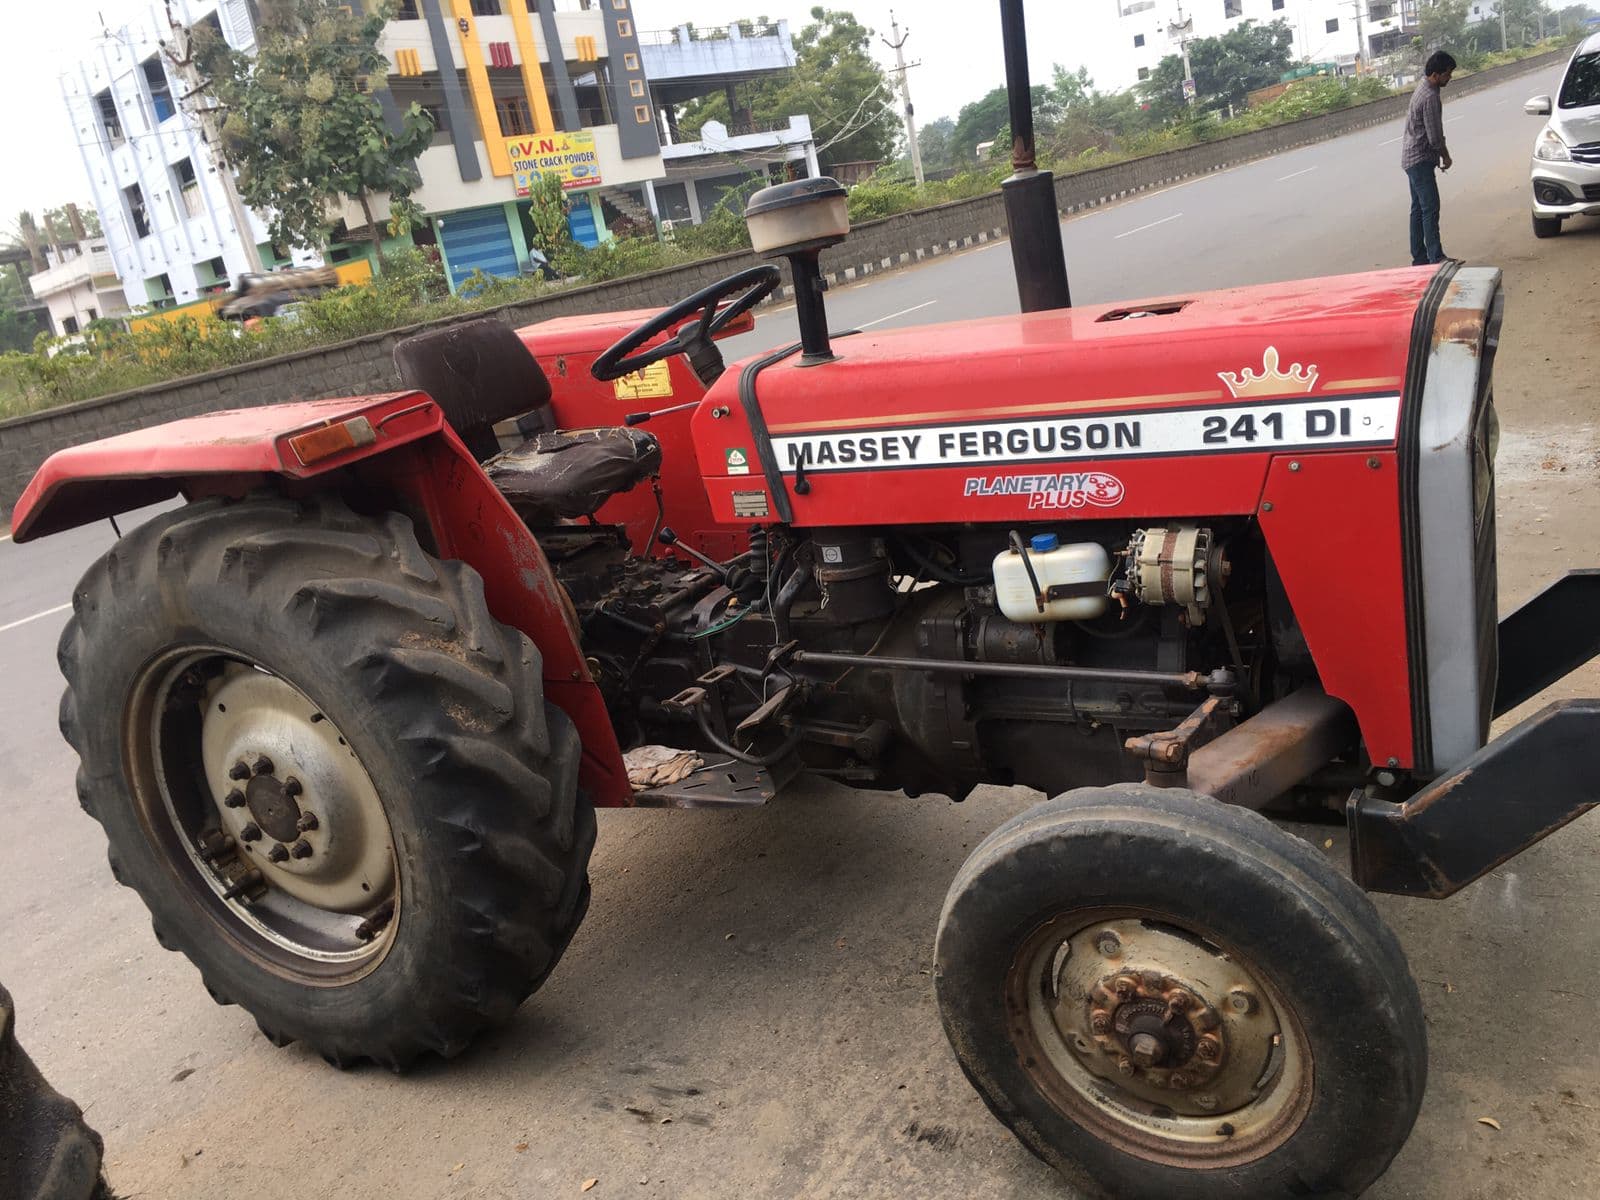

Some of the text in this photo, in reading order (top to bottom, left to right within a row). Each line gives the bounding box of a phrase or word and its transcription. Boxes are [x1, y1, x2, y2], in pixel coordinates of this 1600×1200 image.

[518, 139, 560, 156] V.N.
[514, 151, 595, 171] STONE CRACK POWDER
[1202, 407, 1350, 443] 241 DI
[787, 421, 1141, 465] MASSEY FERGUSON
[965, 474, 1088, 495] PLANETARY
[1029, 490, 1086, 508] PLUS
